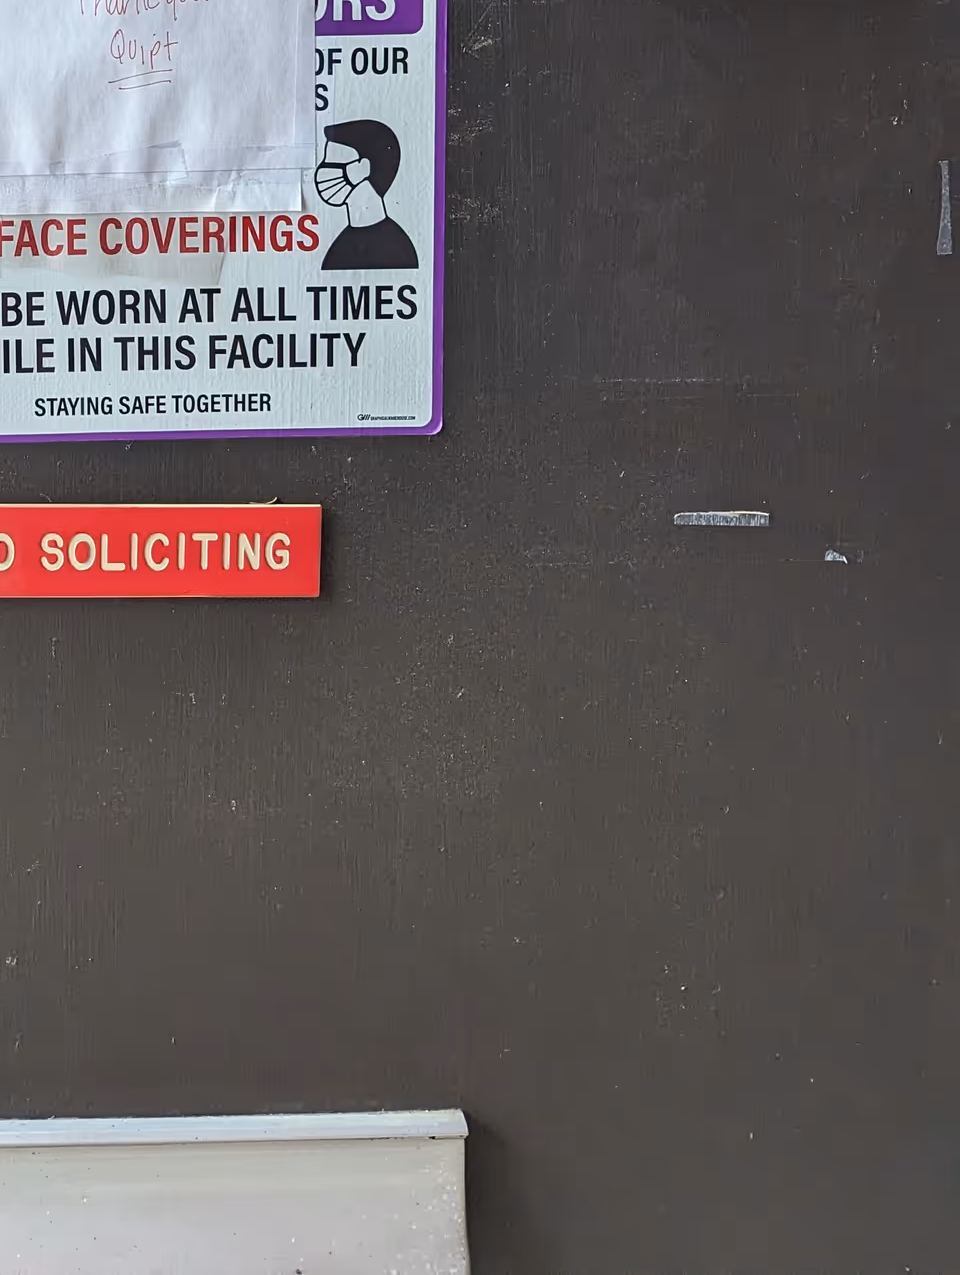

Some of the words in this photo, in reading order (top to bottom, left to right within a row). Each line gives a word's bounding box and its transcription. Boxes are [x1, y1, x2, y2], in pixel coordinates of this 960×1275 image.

[110, 29, 179, 70] Quipt
[351, 47, 409, 75] OUR
[99, 214, 319, 255] COVERINGS
[1, 291, 45, 327] BE
[55, 288, 166, 326] WORN
[178, 287, 221, 323] AT
[231, 286, 297, 322] ALL
[305, 284, 418, 321] TIMES
[67, 336, 102, 372] IN
[113, 334, 196, 371] THIS
[208, 332, 366, 369] FACILITY
[34, 396, 112, 417] STAYING
[118, 395, 167, 415] SAFE
[171, 393, 271, 413] TOGETHER
[39, 532, 291, 572] SOLICITING
